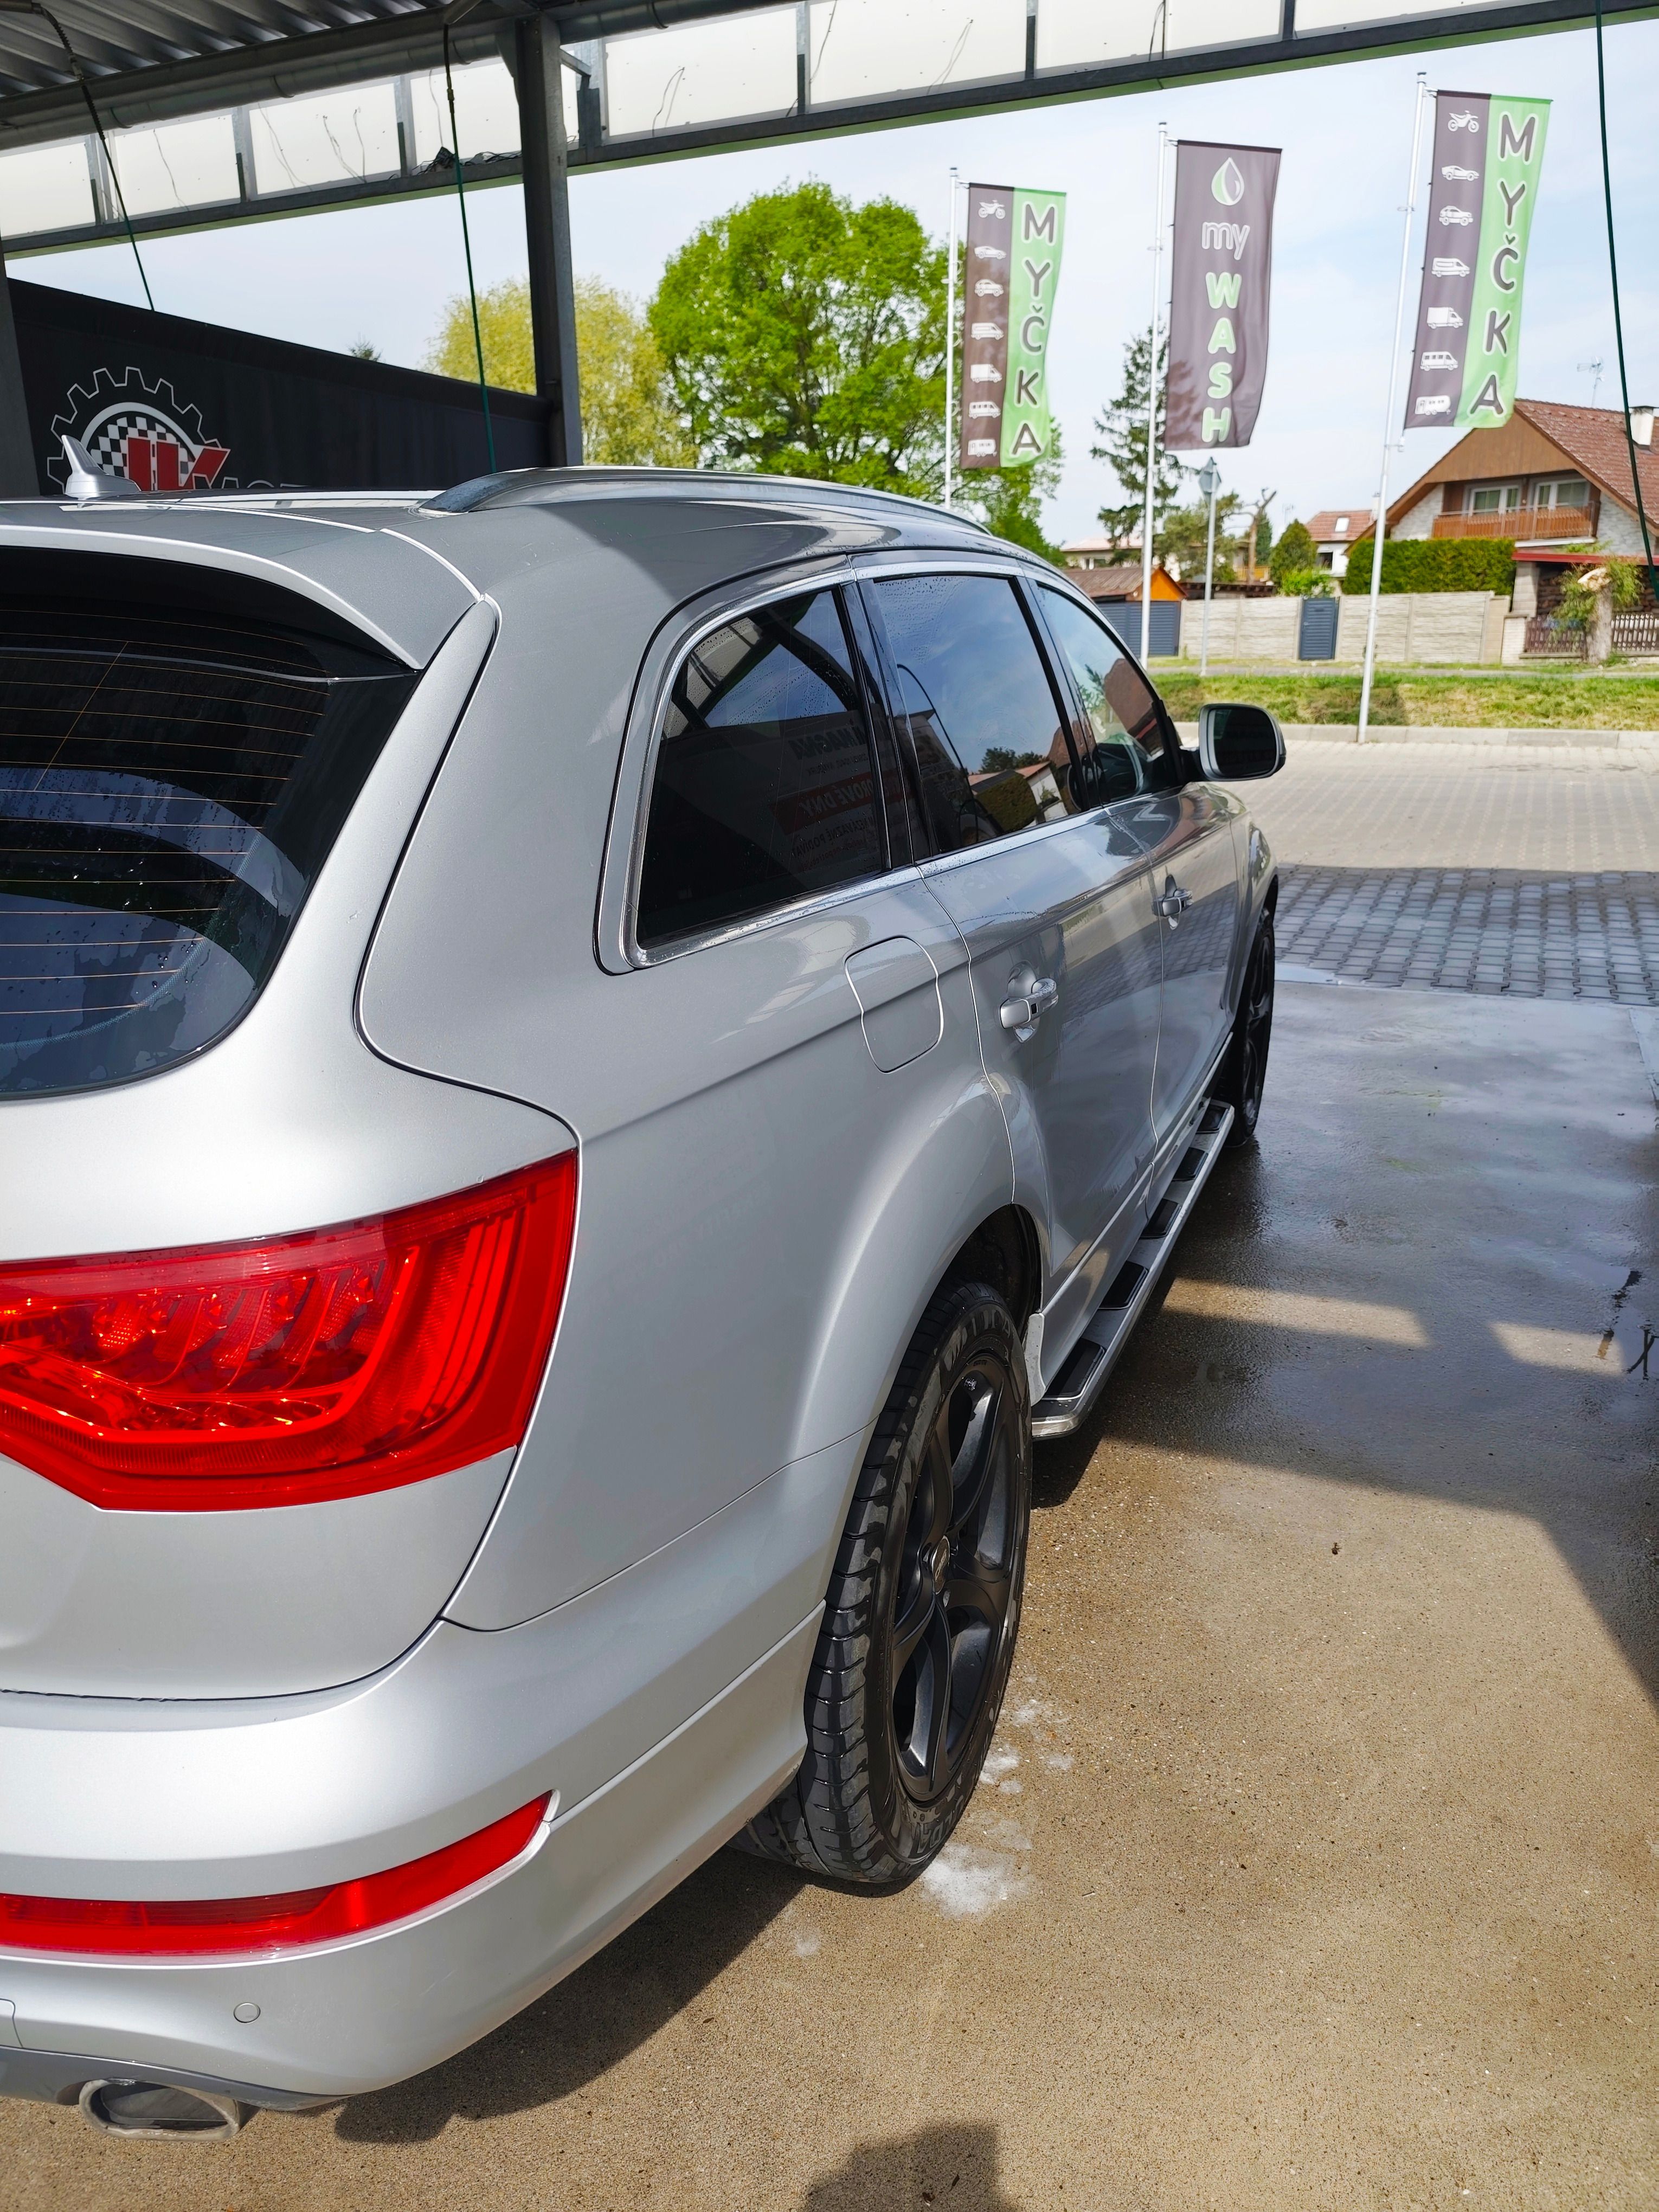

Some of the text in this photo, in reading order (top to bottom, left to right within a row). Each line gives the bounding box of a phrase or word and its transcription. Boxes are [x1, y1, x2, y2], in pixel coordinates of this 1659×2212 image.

[1011, 201, 1056, 456] MYČKA
[1202, 222, 1250, 260] my
[1467, 111, 1538, 418] MYČKA
[1202, 272, 1242, 442] WASH
